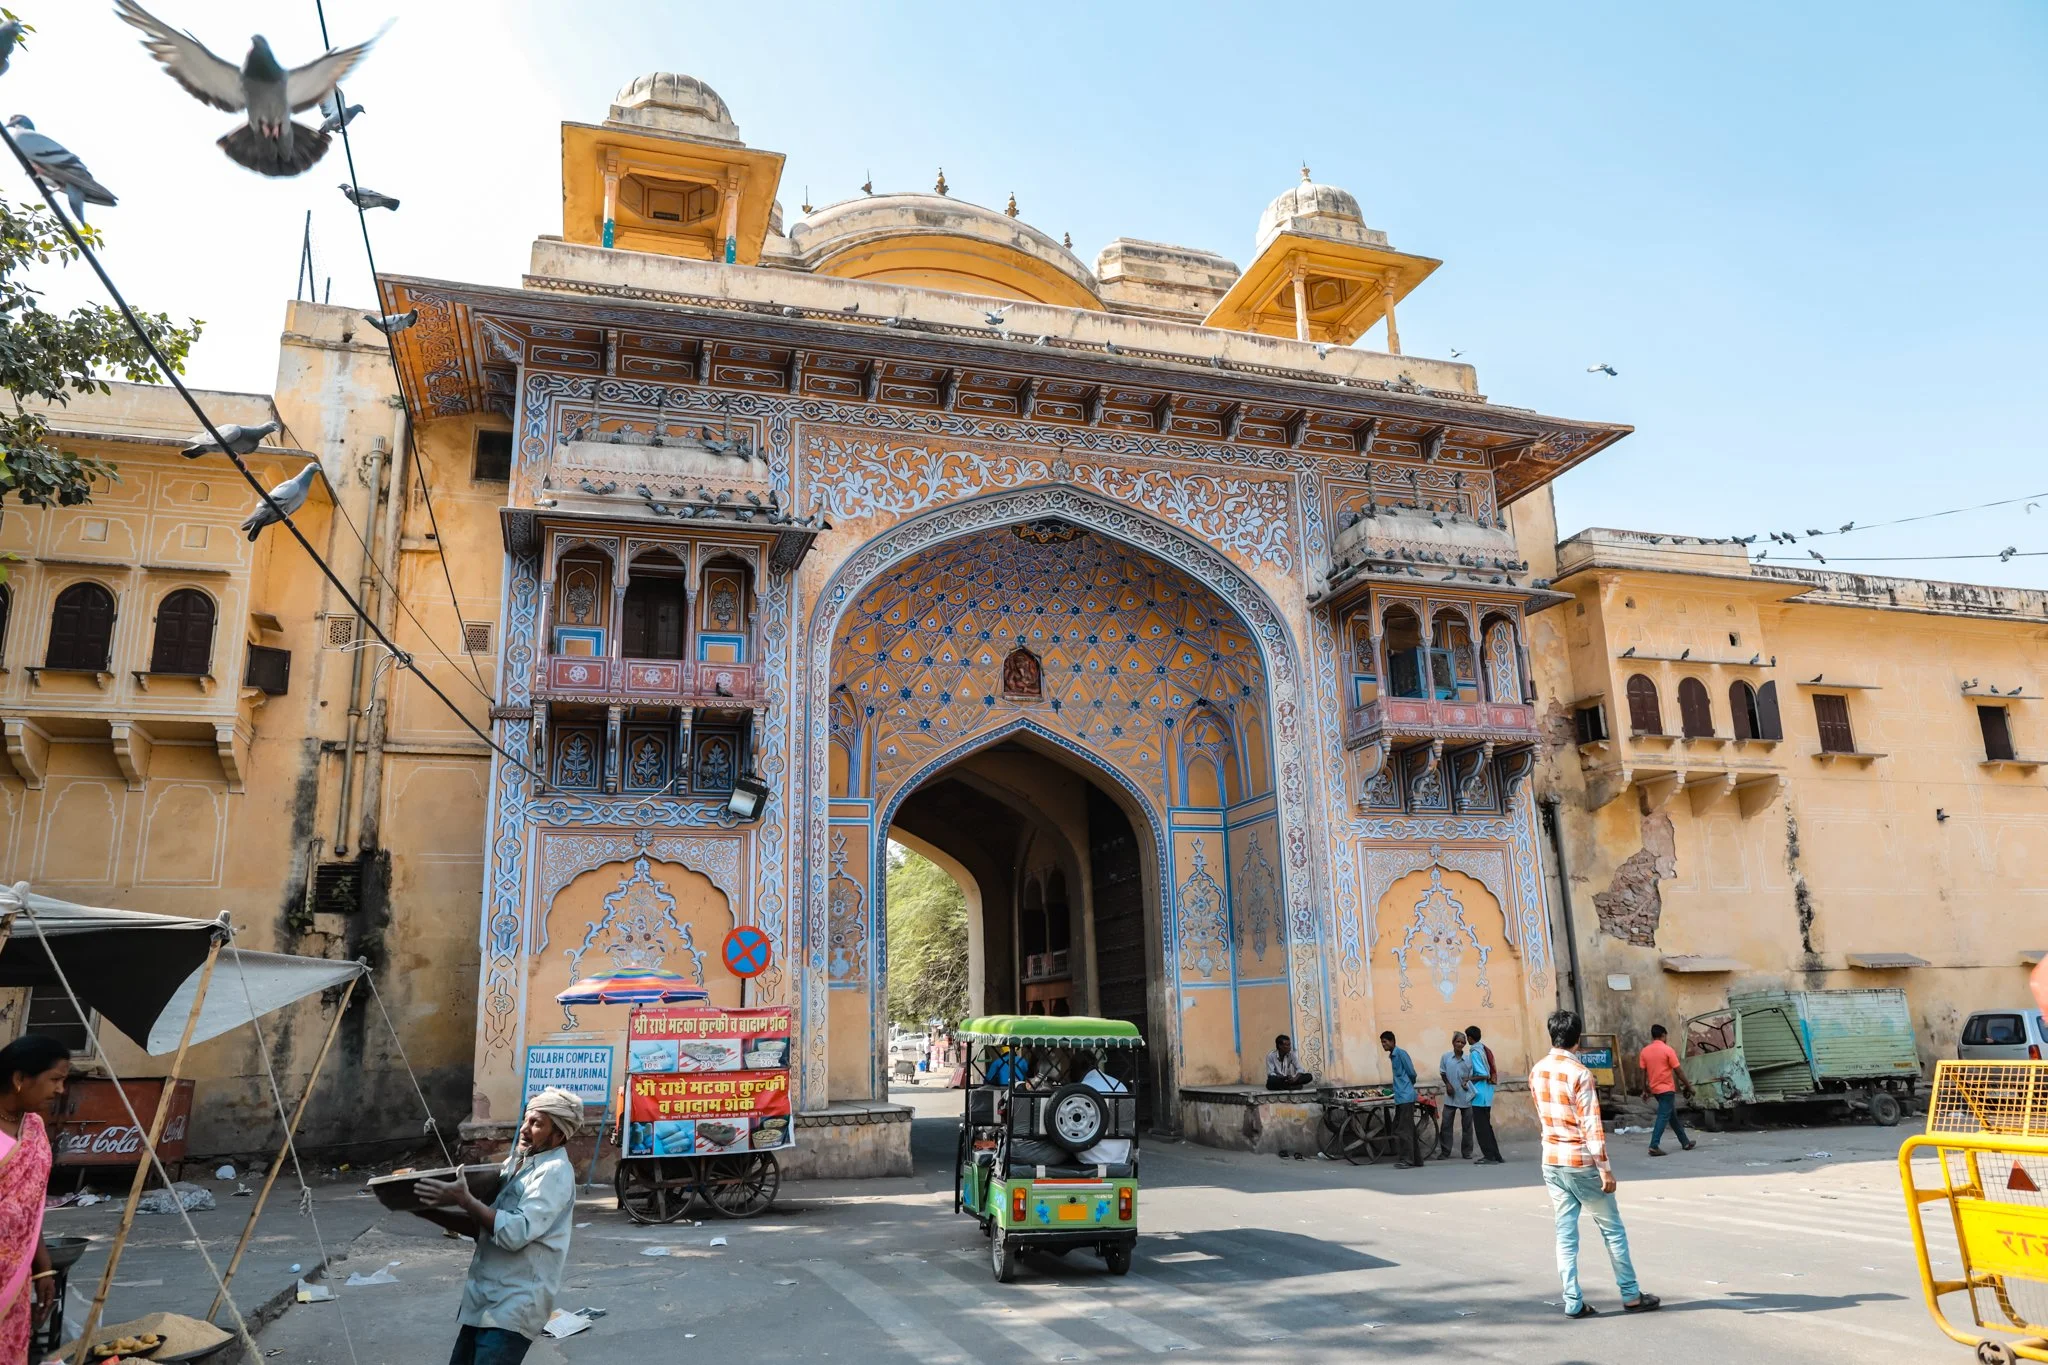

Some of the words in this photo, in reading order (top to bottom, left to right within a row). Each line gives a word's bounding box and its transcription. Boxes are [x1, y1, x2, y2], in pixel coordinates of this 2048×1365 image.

[634, 1014, 648, 1034] श्री
[649, 1014, 667, 1034] राधे
[668, 1018, 697, 1034] मटका
[699, 1014, 729, 1039] कुल्फी
[730, 1017, 738, 1034] व
[739, 1017, 769, 1034] बादाम
[769, 1012, 788, 1032] शेक
[530, 1052, 564, 1064] SULABH
[565, 1052, 606, 1063] COMPLEX
[578, 1067, 607, 1079] URINAL
[634, 1079, 657, 1096] श्री
[659, 1078, 688, 1096] राधे
[690, 1081, 737, 1095] मटका
[739, 1075, 787, 1097] कुल्फी
[658, 1100, 671, 1114] व
[673, 1098, 722, 1114] बादाम
[724, 1094, 756, 1112] शेक
